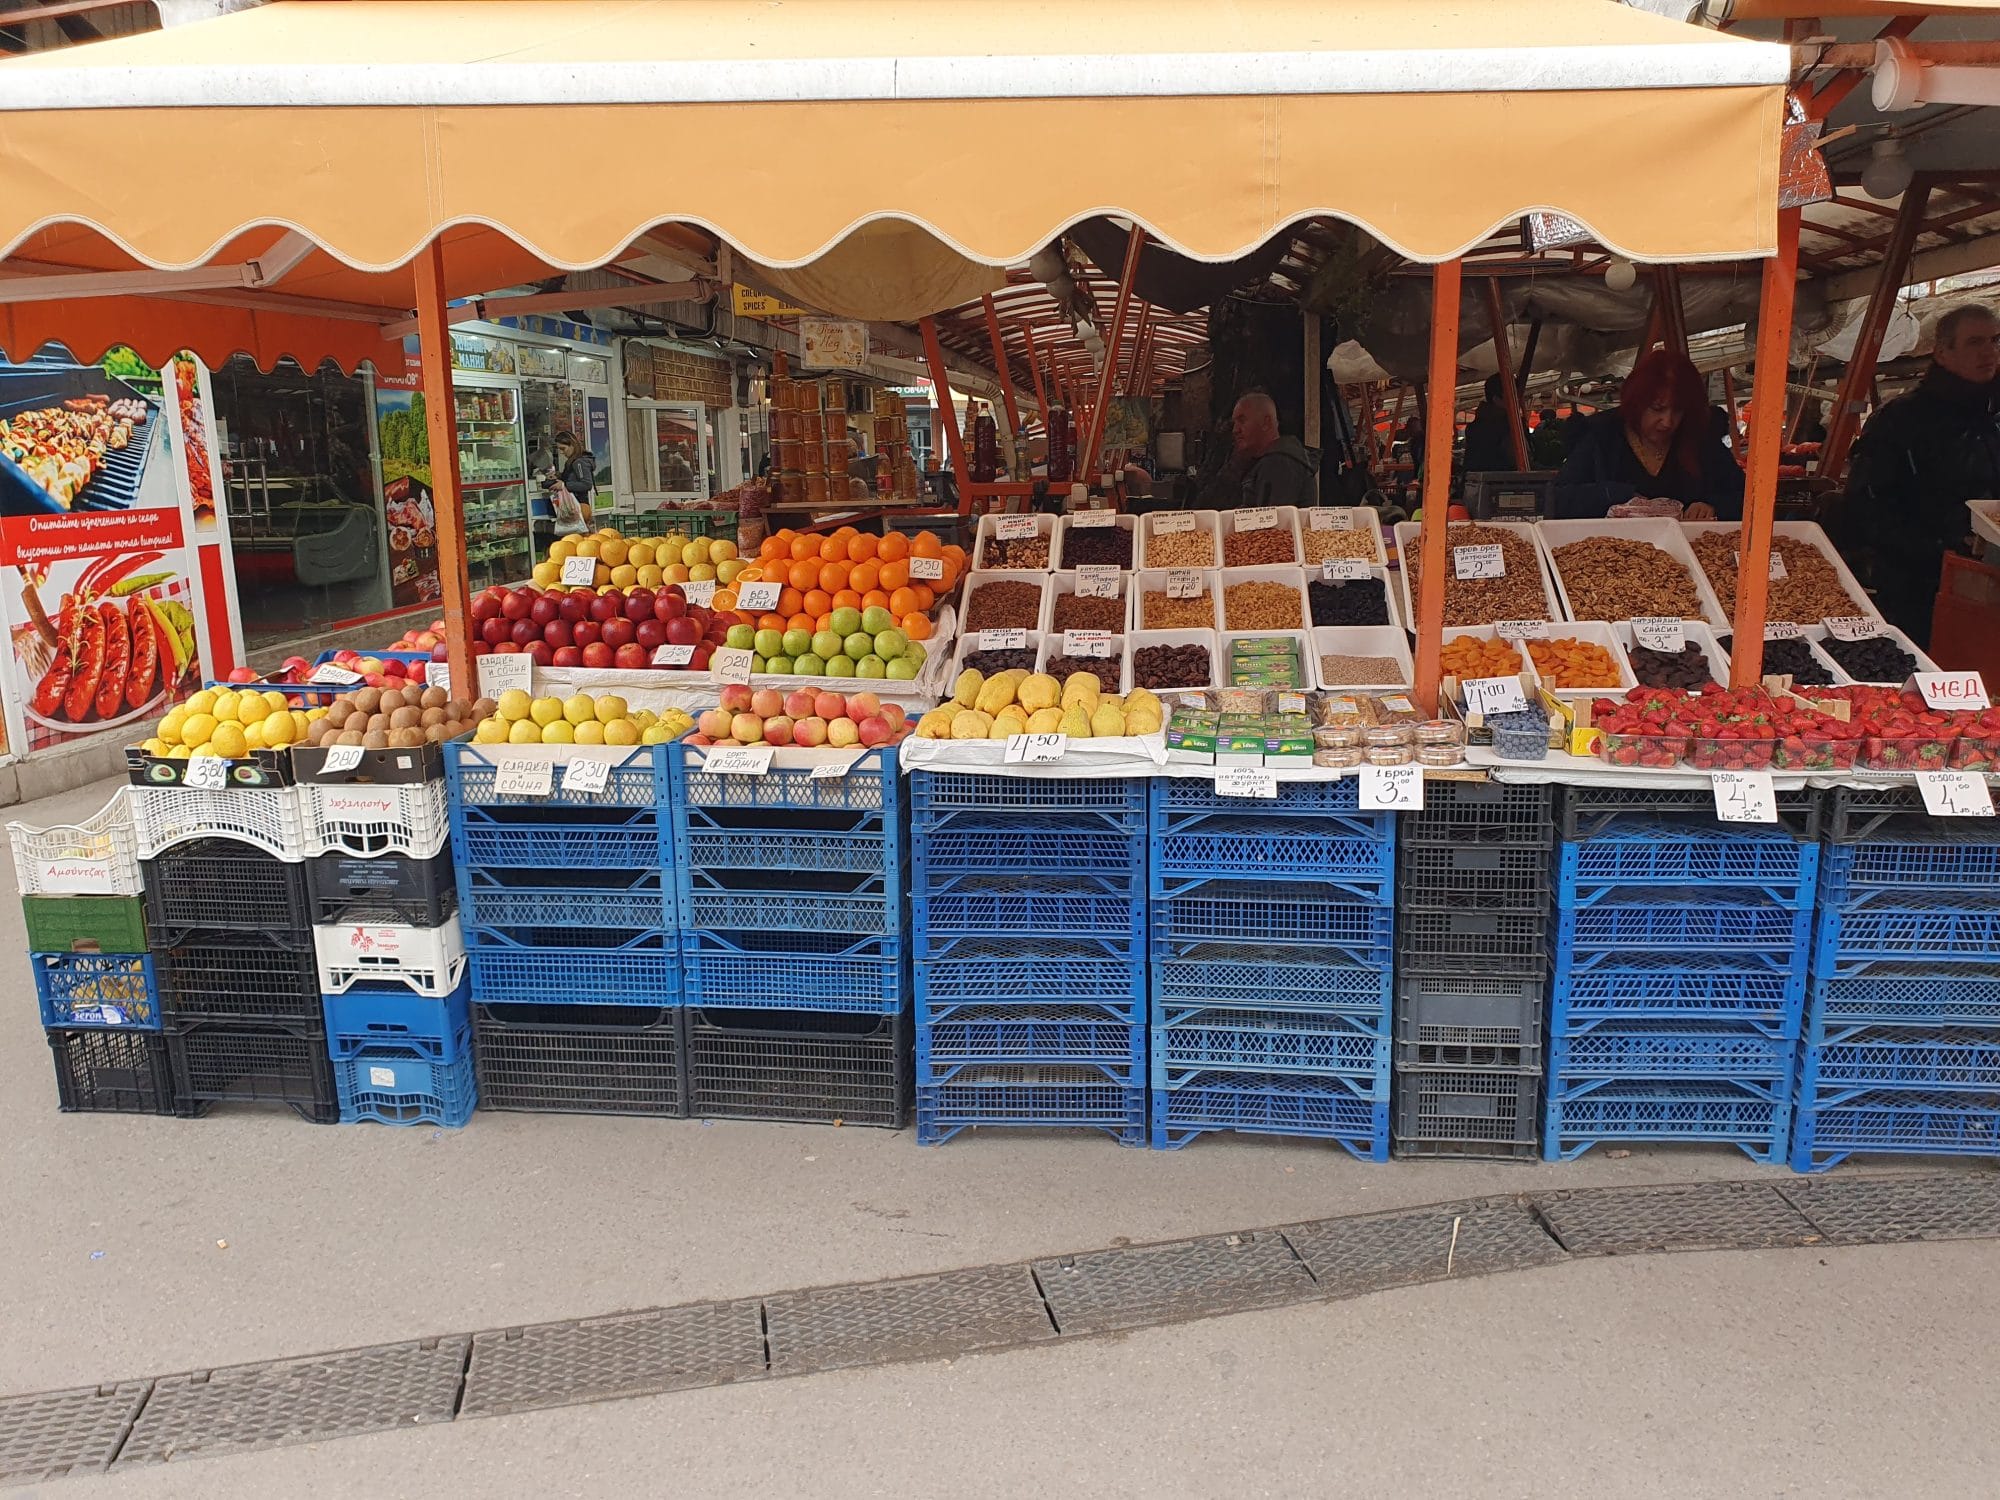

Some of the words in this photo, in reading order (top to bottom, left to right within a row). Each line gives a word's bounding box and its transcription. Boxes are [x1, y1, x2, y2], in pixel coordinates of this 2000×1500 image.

[743, 302, 766, 310] SPICES
[29, 515, 79, 532] Опитайте
[127, 516, 137, 525] на
[63, 544, 78, 554] от
[78, 541, 113, 553] нашата
[114, 537, 139, 550] топла
[1480, 545, 1500, 553] ОРЕХ
[739, 599, 777, 607] СЕМКИ
[480, 655, 514, 666] СЛАДКА
[497, 664, 527, 675] СОЧНА
[1928, 678, 1981, 699] МЕД
[502, 759, 550, 772] СЛАДКА
[1375, 769, 1382, 778] 1
[1384, 768, 1415, 780] БРОЙ
[501, 780, 543, 791] СОЧНА
[48, 865, 106, 878] Αμούντζας
